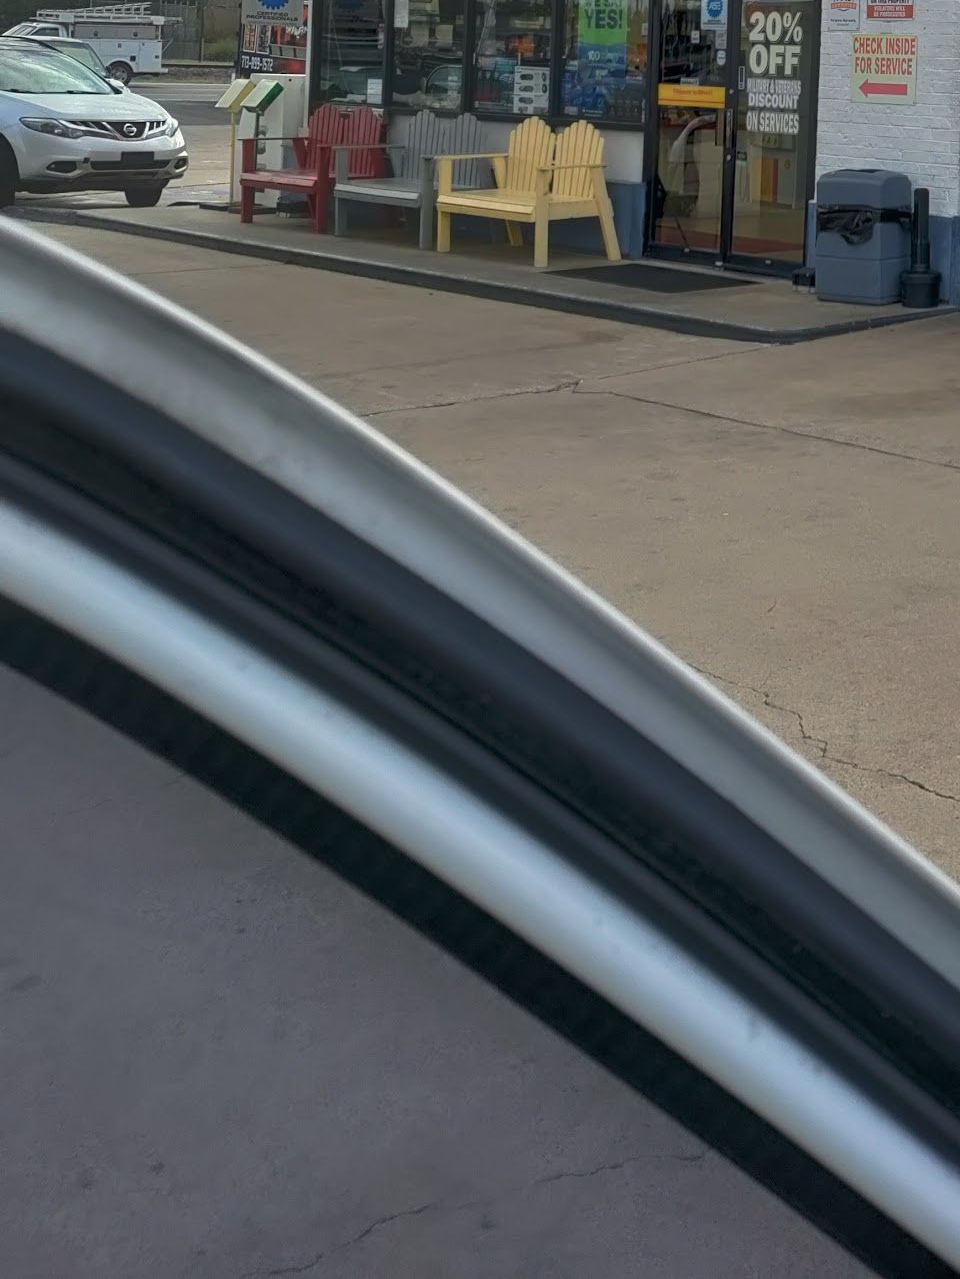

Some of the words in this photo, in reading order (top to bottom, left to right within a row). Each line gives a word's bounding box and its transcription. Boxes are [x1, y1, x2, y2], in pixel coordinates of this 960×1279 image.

[584, 8, 623, 30] YES!
[749, 10, 804, 43] 20%
[853, 36, 883, 55] CHECK
[885, 37, 916, 56] INSIDE
[749, 44, 802, 76] OFF
[855, 56, 872, 74] FOR
[874, 57, 913, 76] SERVICE
[748, 92, 799, 110] DISCOUNT
[746, 110, 759, 131] ON
[759, 112, 800, 134] SERVICES
